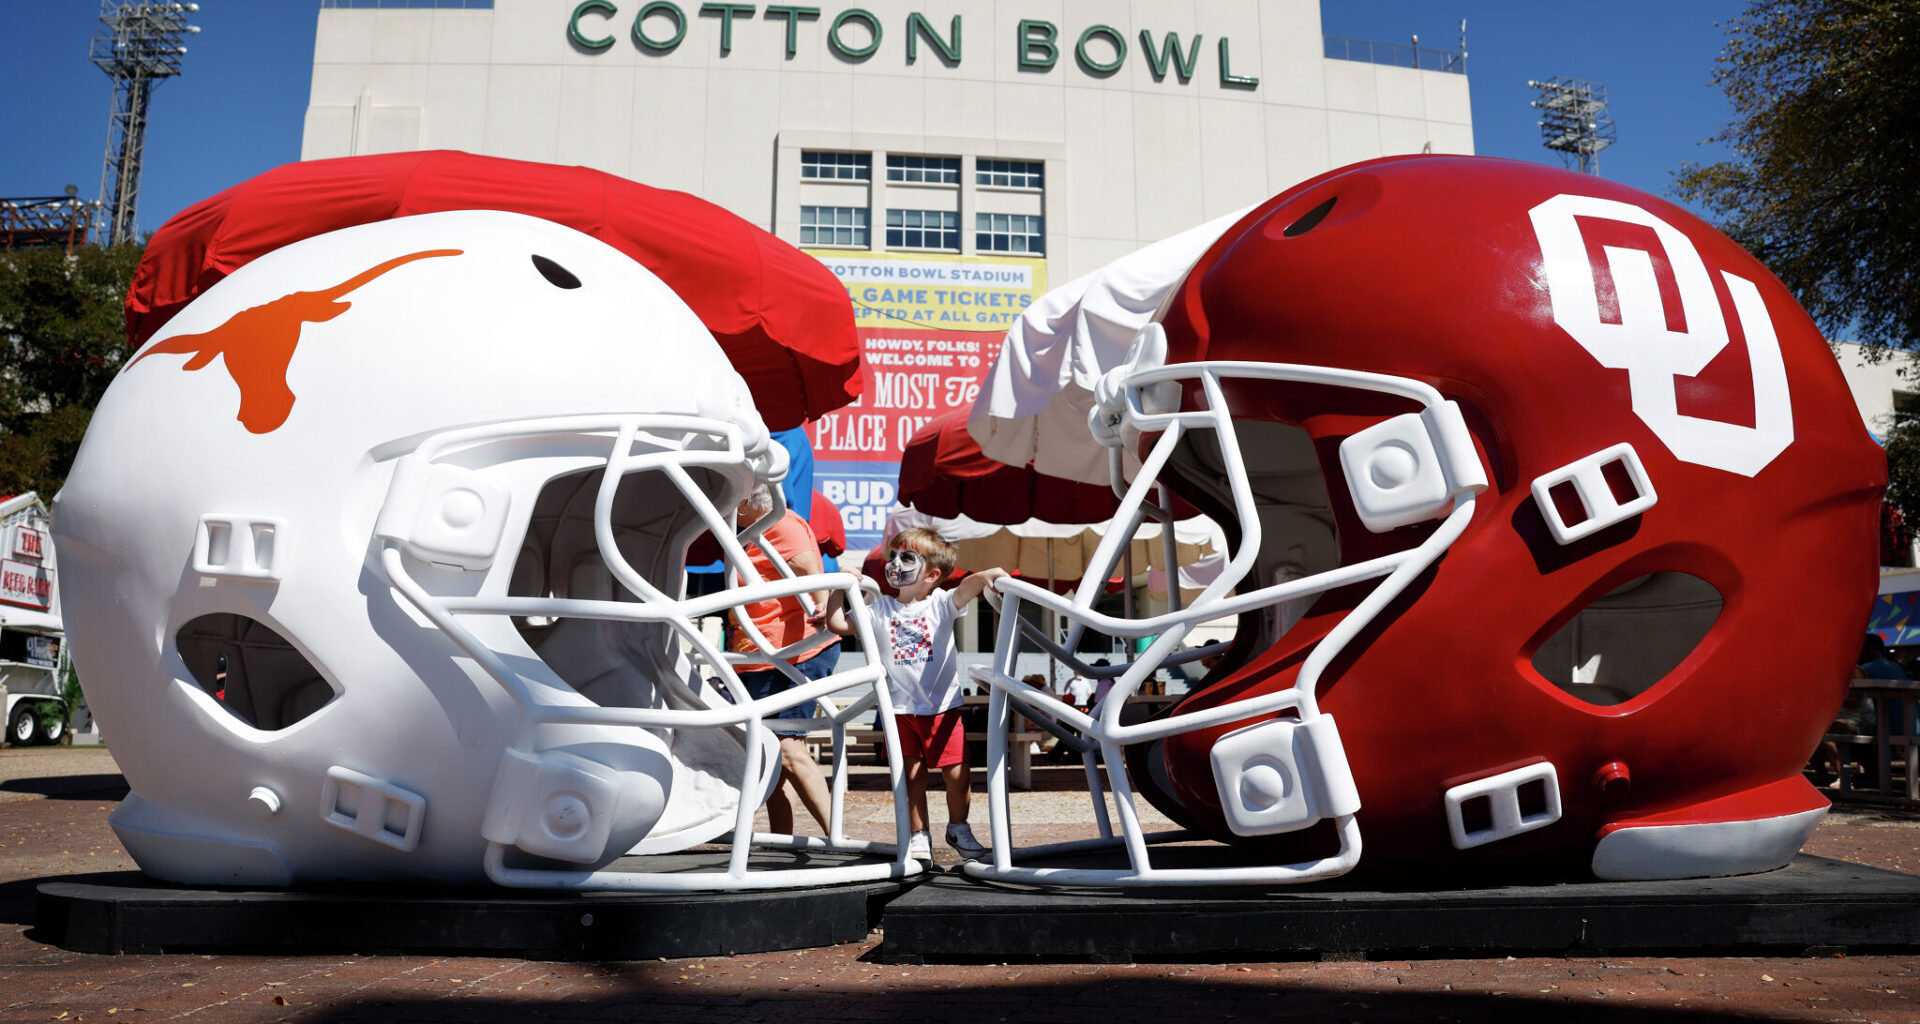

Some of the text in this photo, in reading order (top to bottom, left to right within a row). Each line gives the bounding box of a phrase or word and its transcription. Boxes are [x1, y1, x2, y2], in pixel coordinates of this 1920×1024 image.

[566, 0, 1260, 88] COTTON BOWL
[826, 264, 1024, 283] OTTON BOWL STADIUM
[863, 288, 928, 305] GAME
[935, 290, 1033, 308] TICKETS
[853, 307, 908, 321] EPTED
[912, 309, 934, 322] AT
[940, 310, 972, 323] ALL
[865, 338, 980, 352] HOWDY, FOLKS!
[1528, 193, 1795, 478] OU
[865, 353, 980, 367] WELCOME TO
[874, 372, 940, 409] MOST
[814, 414, 887, 451] PLACE
[822, 480, 894, 505] BUD
[21, 532, 42, 554] THE
